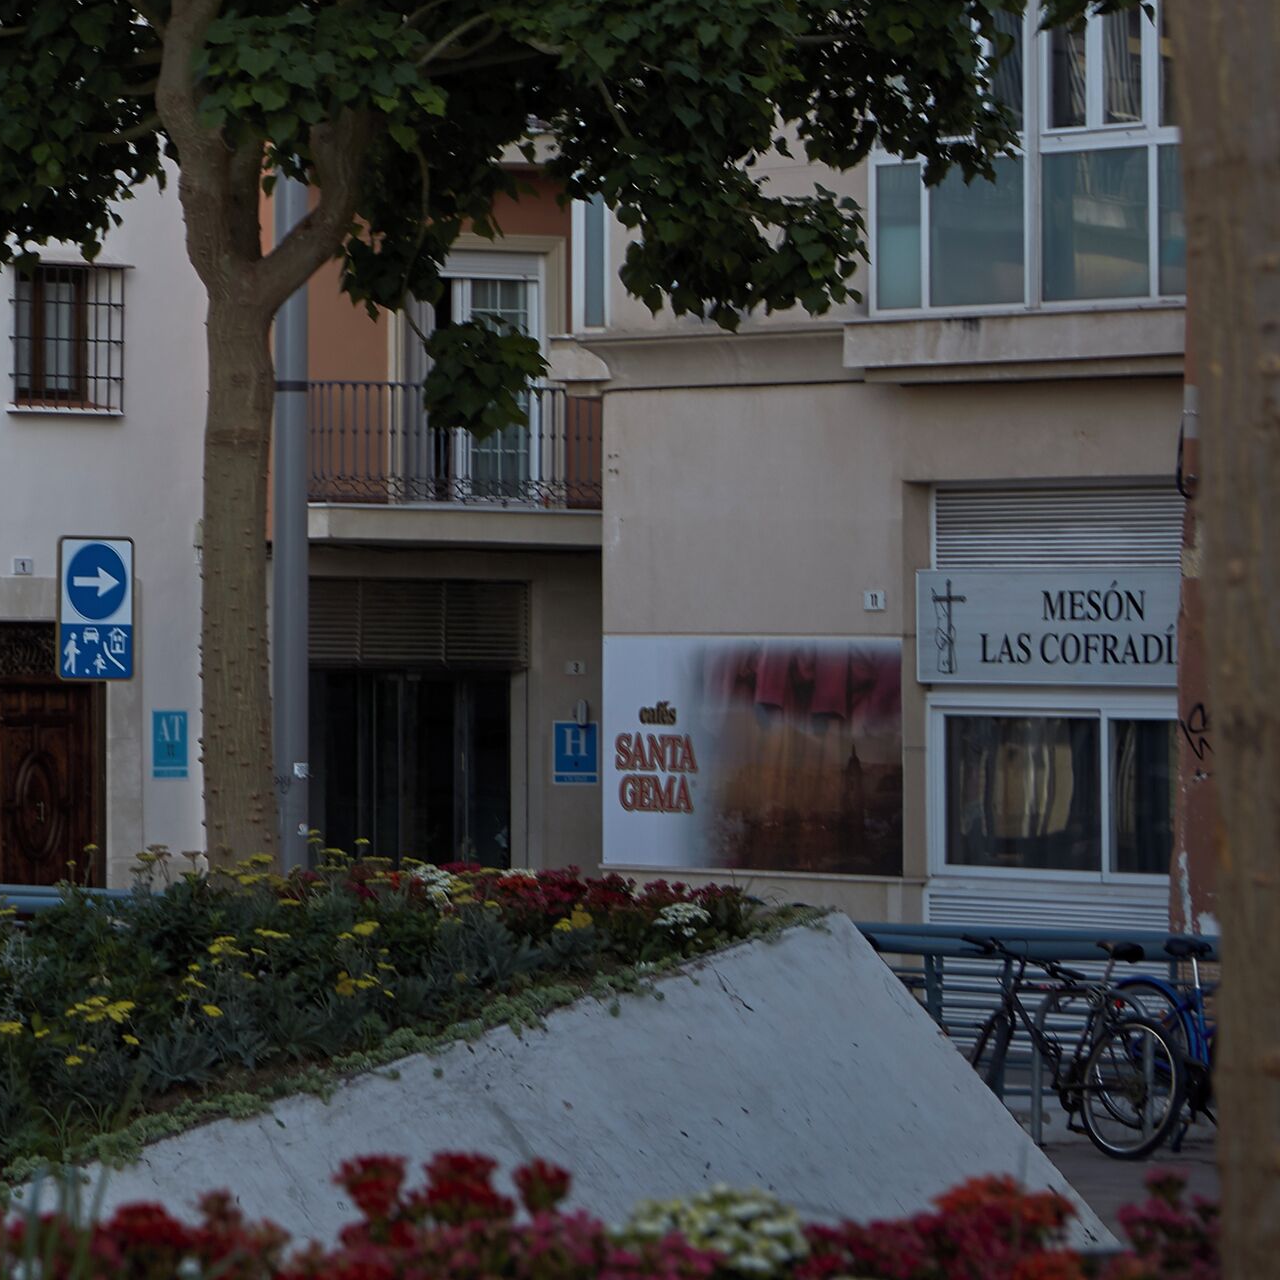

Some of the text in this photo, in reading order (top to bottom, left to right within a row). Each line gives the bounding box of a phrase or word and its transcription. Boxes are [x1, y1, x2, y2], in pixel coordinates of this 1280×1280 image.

[870, 593, 878, 608] 11
[1041, 580, 1146, 621] MESÓN
[979, 623, 1178, 665] LAS COFRADÍ
[158, 714, 184, 741] AT
[639, 701, 677, 725] cafés
[564, 727, 588, 756] H
[615, 731, 698, 774] SANTA
[619, 773, 695, 814] GEMA
